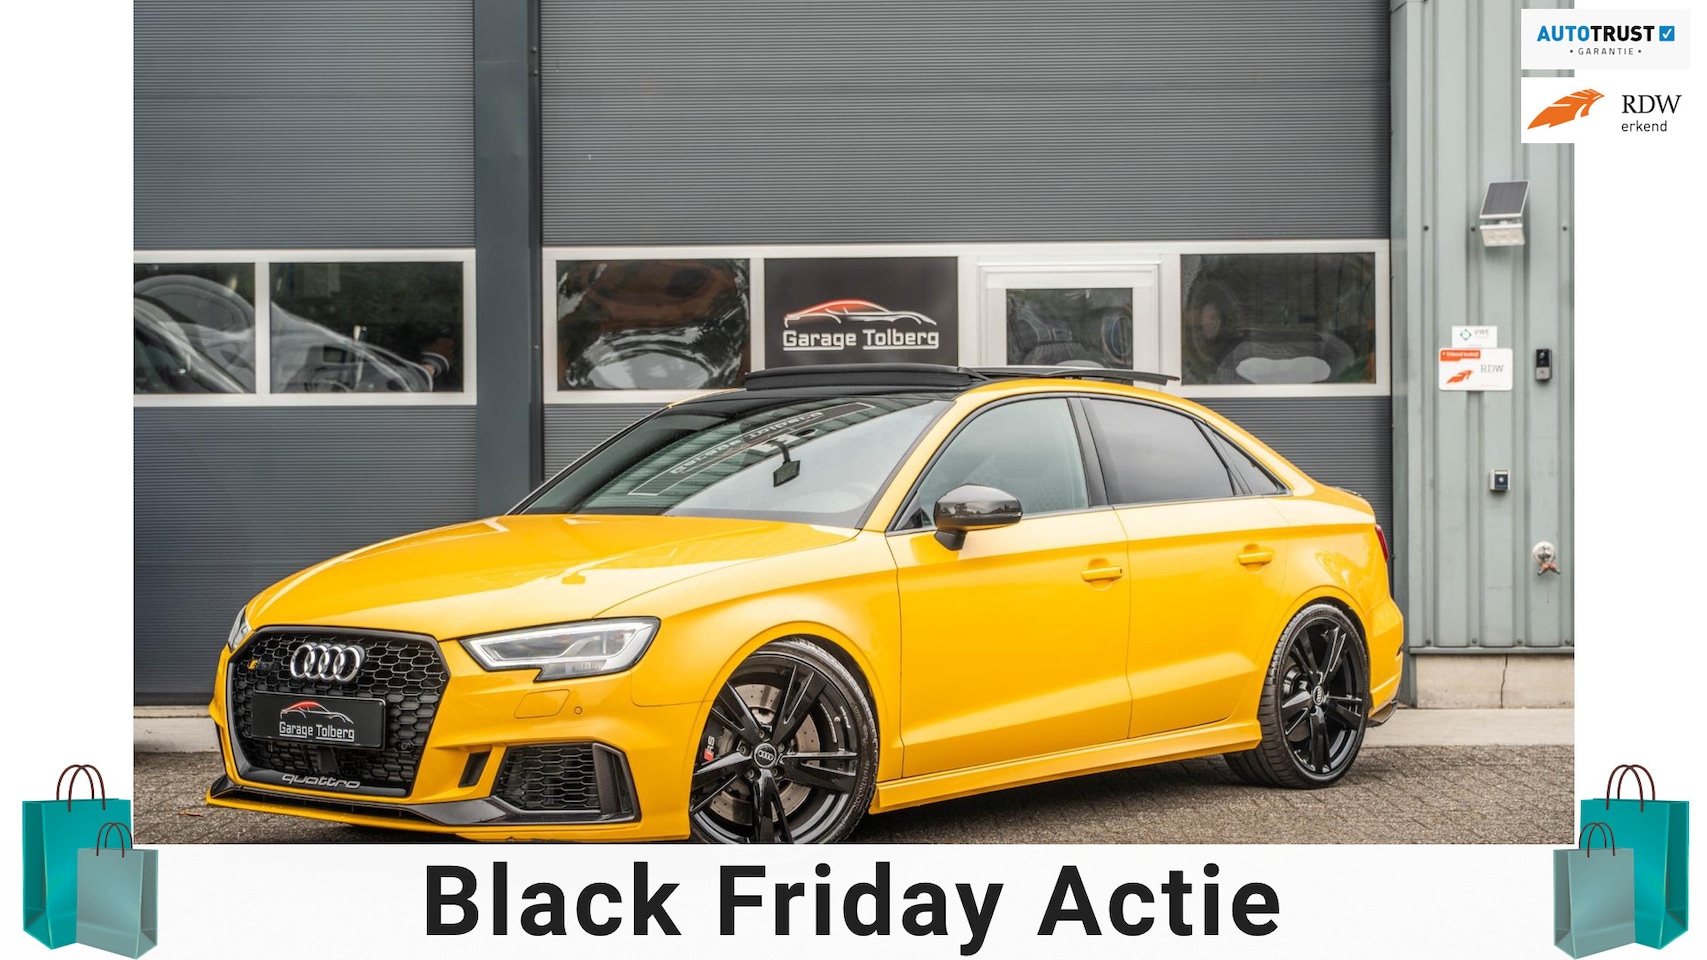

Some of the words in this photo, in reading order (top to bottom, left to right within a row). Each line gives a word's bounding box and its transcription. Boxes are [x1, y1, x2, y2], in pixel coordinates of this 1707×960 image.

[783, 330, 857, 351] Garage
[863, 329, 940, 350] Tolberg
[1480, 364, 1504, 373] RDW
[279, 721, 313, 739] Garage
[315, 723, 355, 743] Tolberg
[281, 773, 361, 789] quattro
